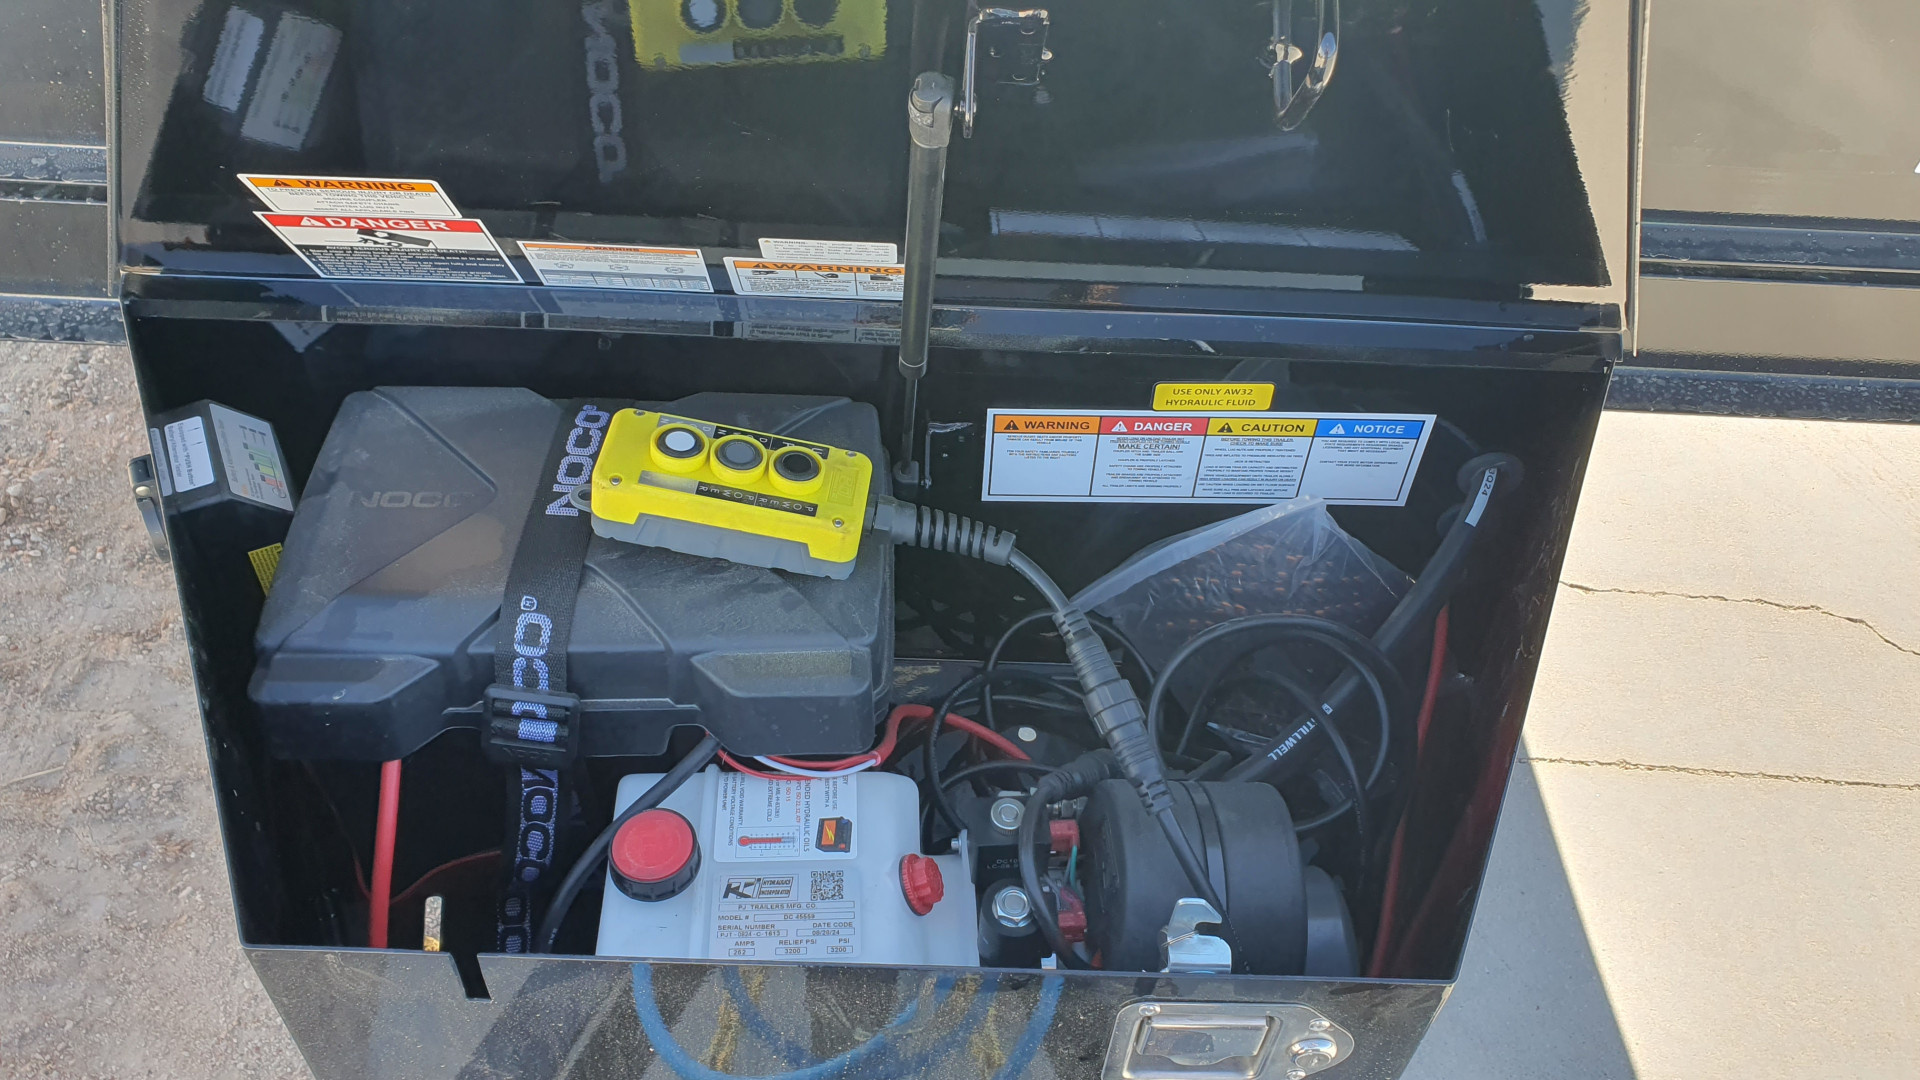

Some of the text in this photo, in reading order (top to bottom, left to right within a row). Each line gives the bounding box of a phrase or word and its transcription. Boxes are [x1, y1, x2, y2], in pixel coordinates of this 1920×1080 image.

[297, 179, 416, 191] WARNING
[326, 217, 450, 231] DANGER
[772, 263, 902, 274] WARNING
[1172, 388, 1254, 396] USE ONLY AW32
[1024, 421, 1090, 430] WARNING
[1134, 422, 1192, 431] DANGER
[1241, 423, 1305, 432] CAUTION
[1353, 424, 1405, 434] NOTICE
[699, 485, 755, 501] POWER
[759, 497, 814, 512] POWER
[1267, 718, 1318, 761] TILLWELL
